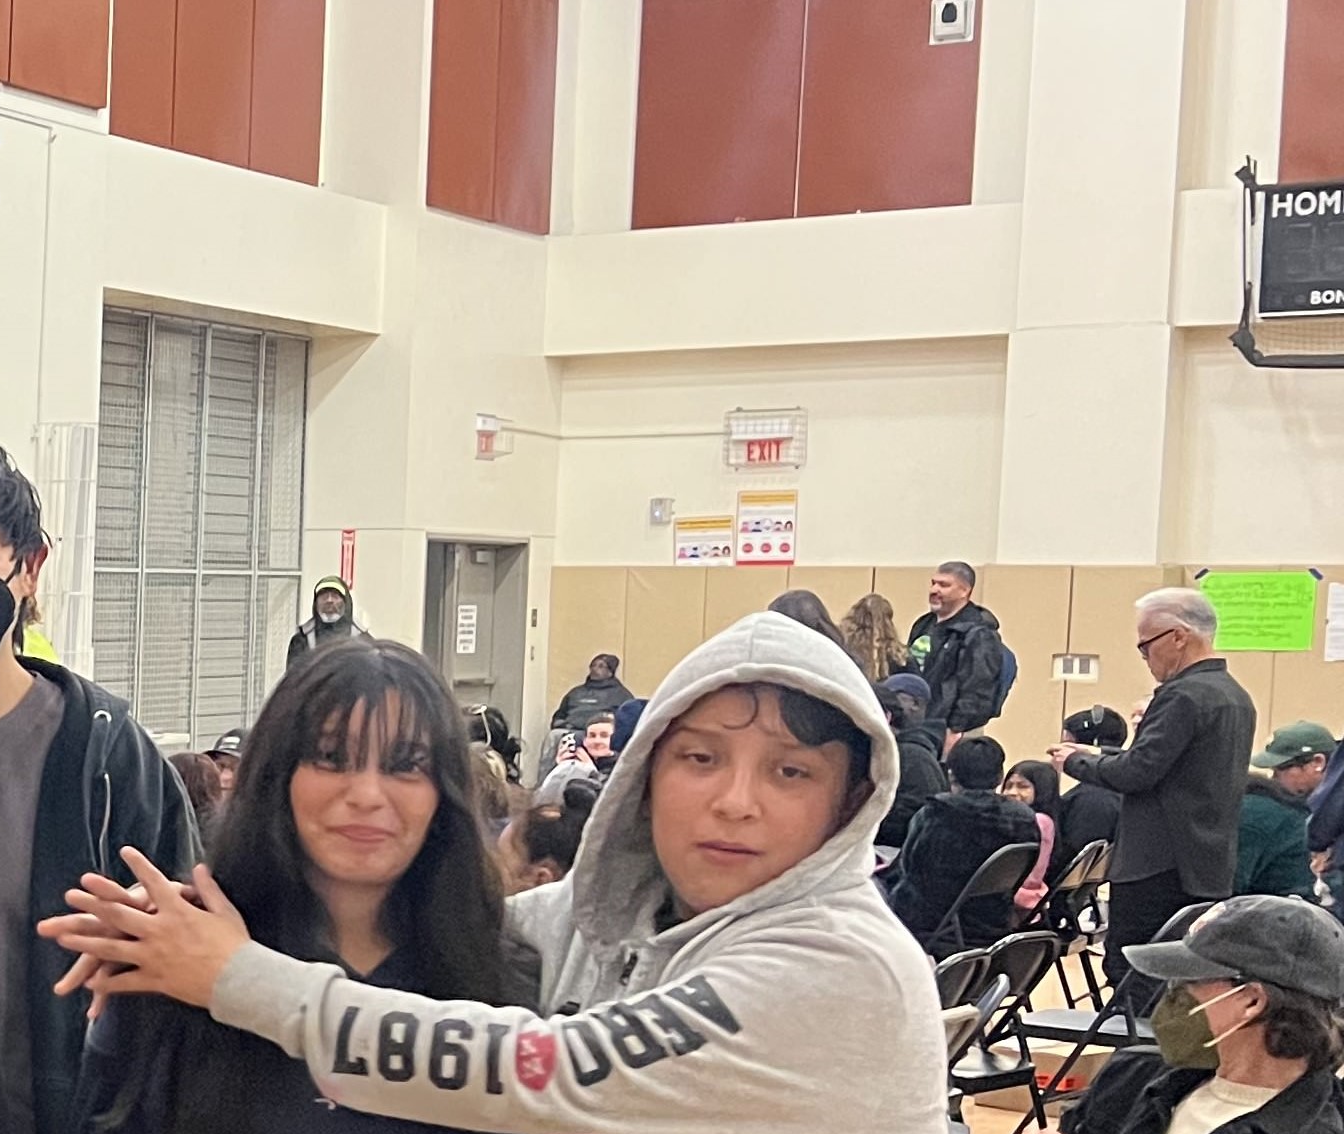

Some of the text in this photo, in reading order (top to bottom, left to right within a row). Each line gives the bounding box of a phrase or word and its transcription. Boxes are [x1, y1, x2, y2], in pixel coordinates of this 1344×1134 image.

[1272, 190, 1344, 218] HOM
[746, 439, 784, 463] EXIT
[332, 1005, 511, 1096] 1987
